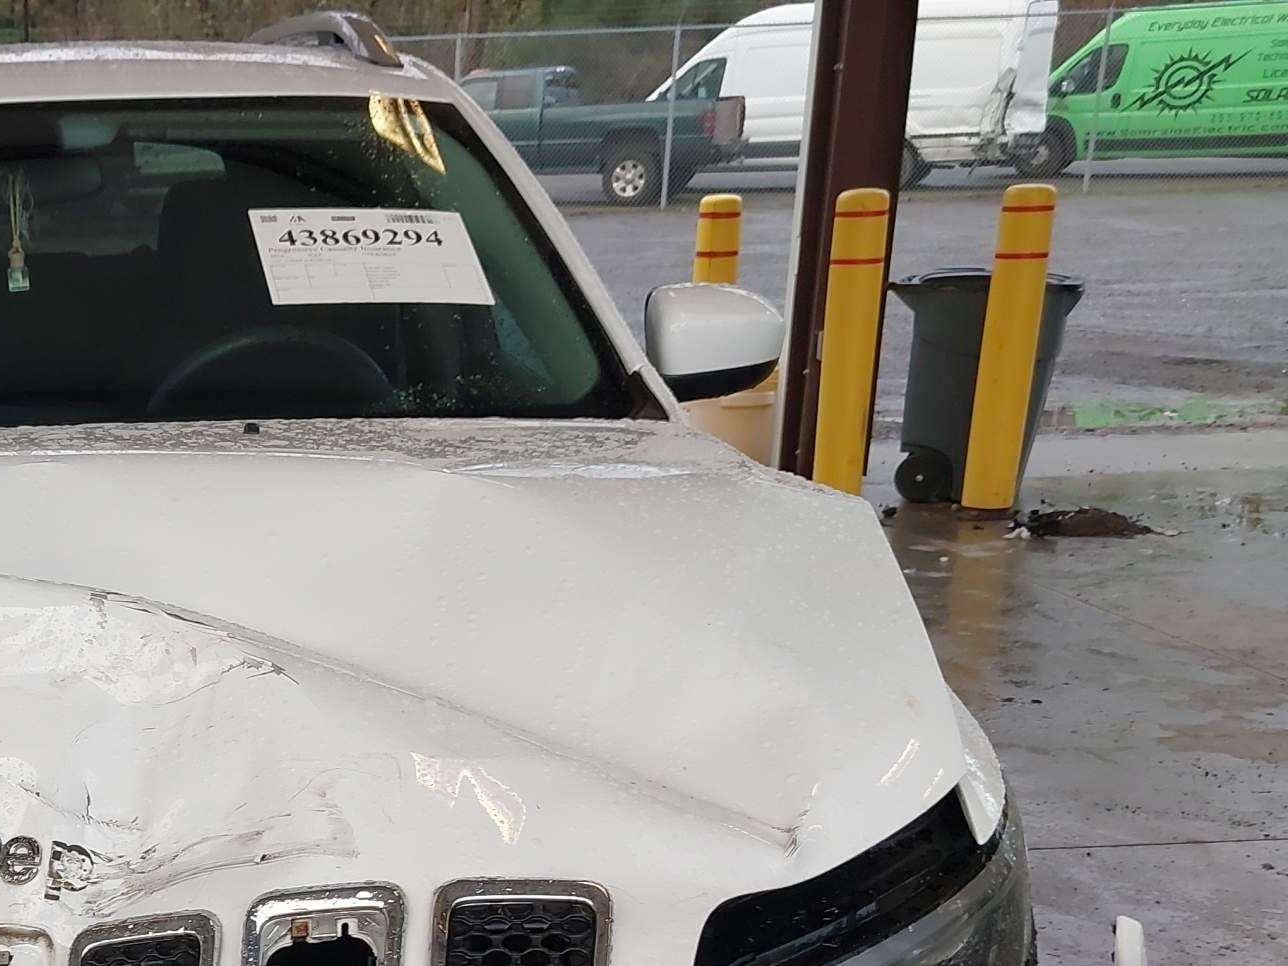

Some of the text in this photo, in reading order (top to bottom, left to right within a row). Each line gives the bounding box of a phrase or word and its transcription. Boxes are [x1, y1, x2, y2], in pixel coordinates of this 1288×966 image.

[1148, 19, 1208, 32] Everyday
[1211, 14, 1274, 28] Electrical
[278, 228, 443, 248] 43869294
